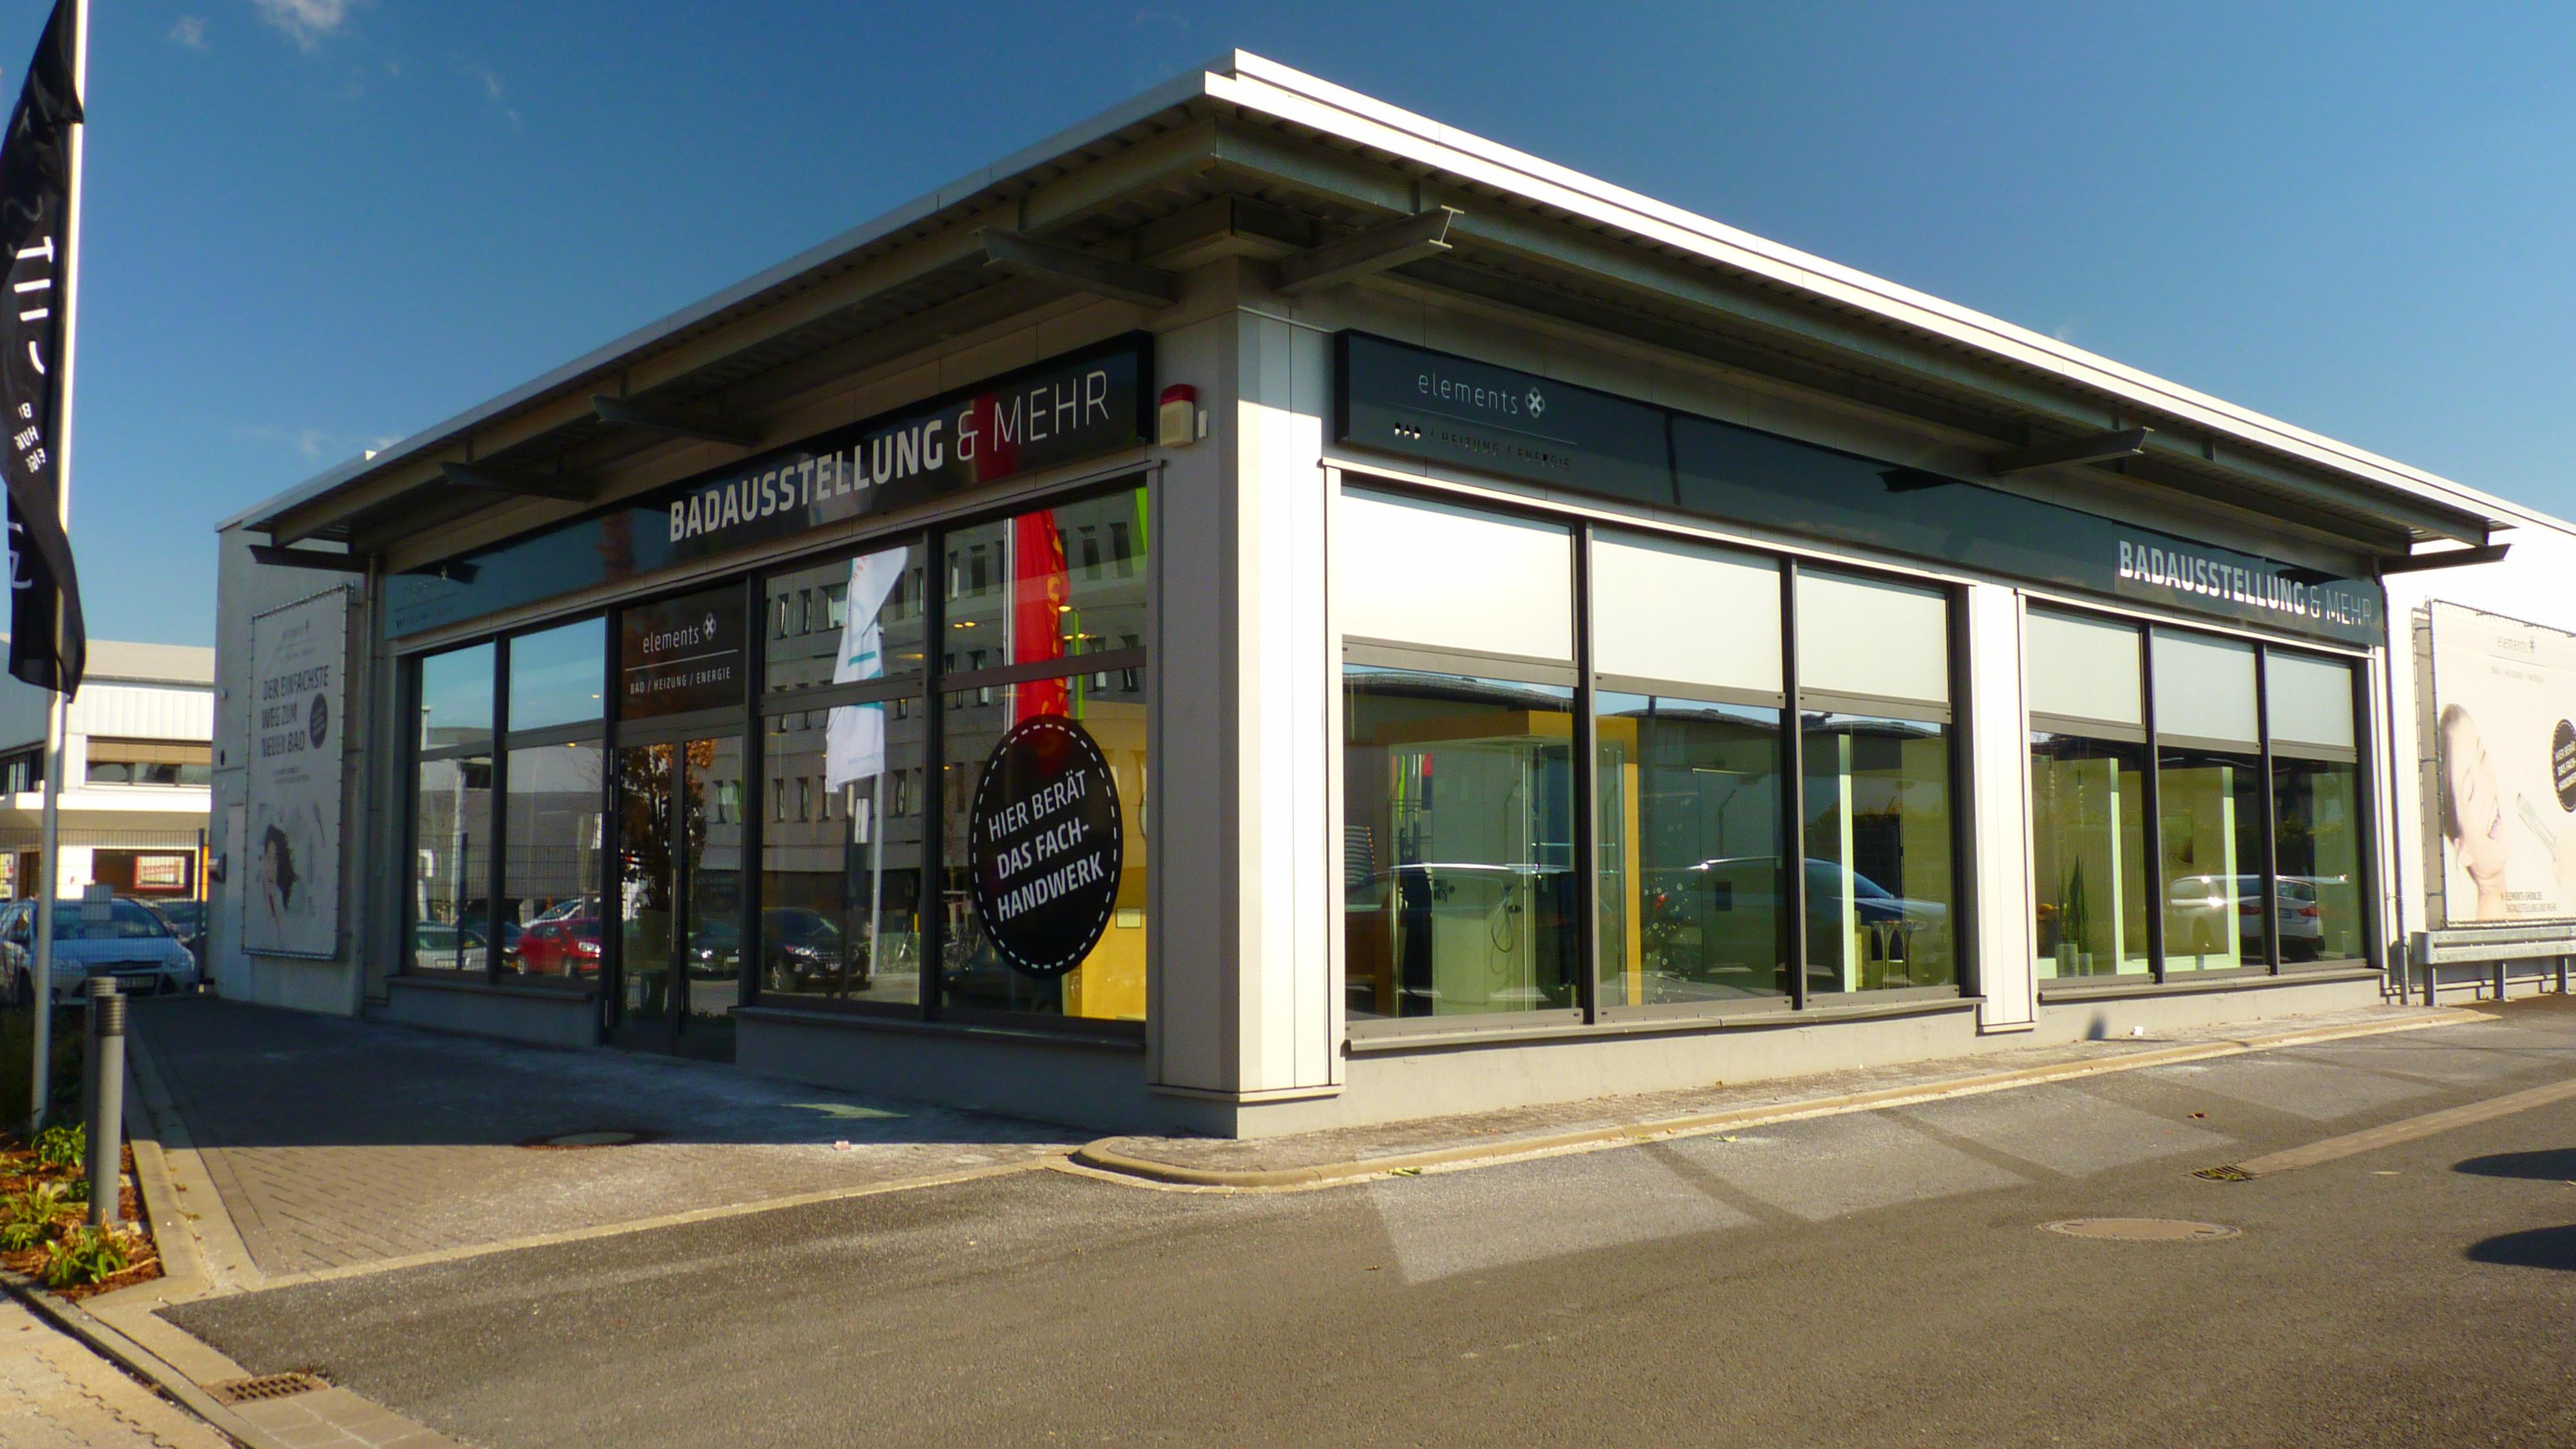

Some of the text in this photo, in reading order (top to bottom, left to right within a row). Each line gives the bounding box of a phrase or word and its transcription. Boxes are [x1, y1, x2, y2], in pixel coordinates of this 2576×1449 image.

[1418, 370, 1518, 415] elements
[670, 370, 1109, 543] BADAUSSTELLUNG & MEHR
[2119, 540, 2372, 626] BADAUSSTELLUNG & MEHR
[643, 625, 699, 654] elements
[262, 665, 329, 701] DER EINFACHSTE
[630, 681, 645, 695] BAD
[654, 674, 687, 691] HEIZUNG
[696, 667, 731, 685] ENERGIE
[261, 706, 279, 730] WEG
[281, 701, 298, 726] ZUM
[261, 730, 306, 758] NEUEN BAD
[988, 770, 1086, 842] HIER BERÄT
[997, 816, 1089, 880] DAS FACH-
[996, 851, 1104, 923] HANDWERK
